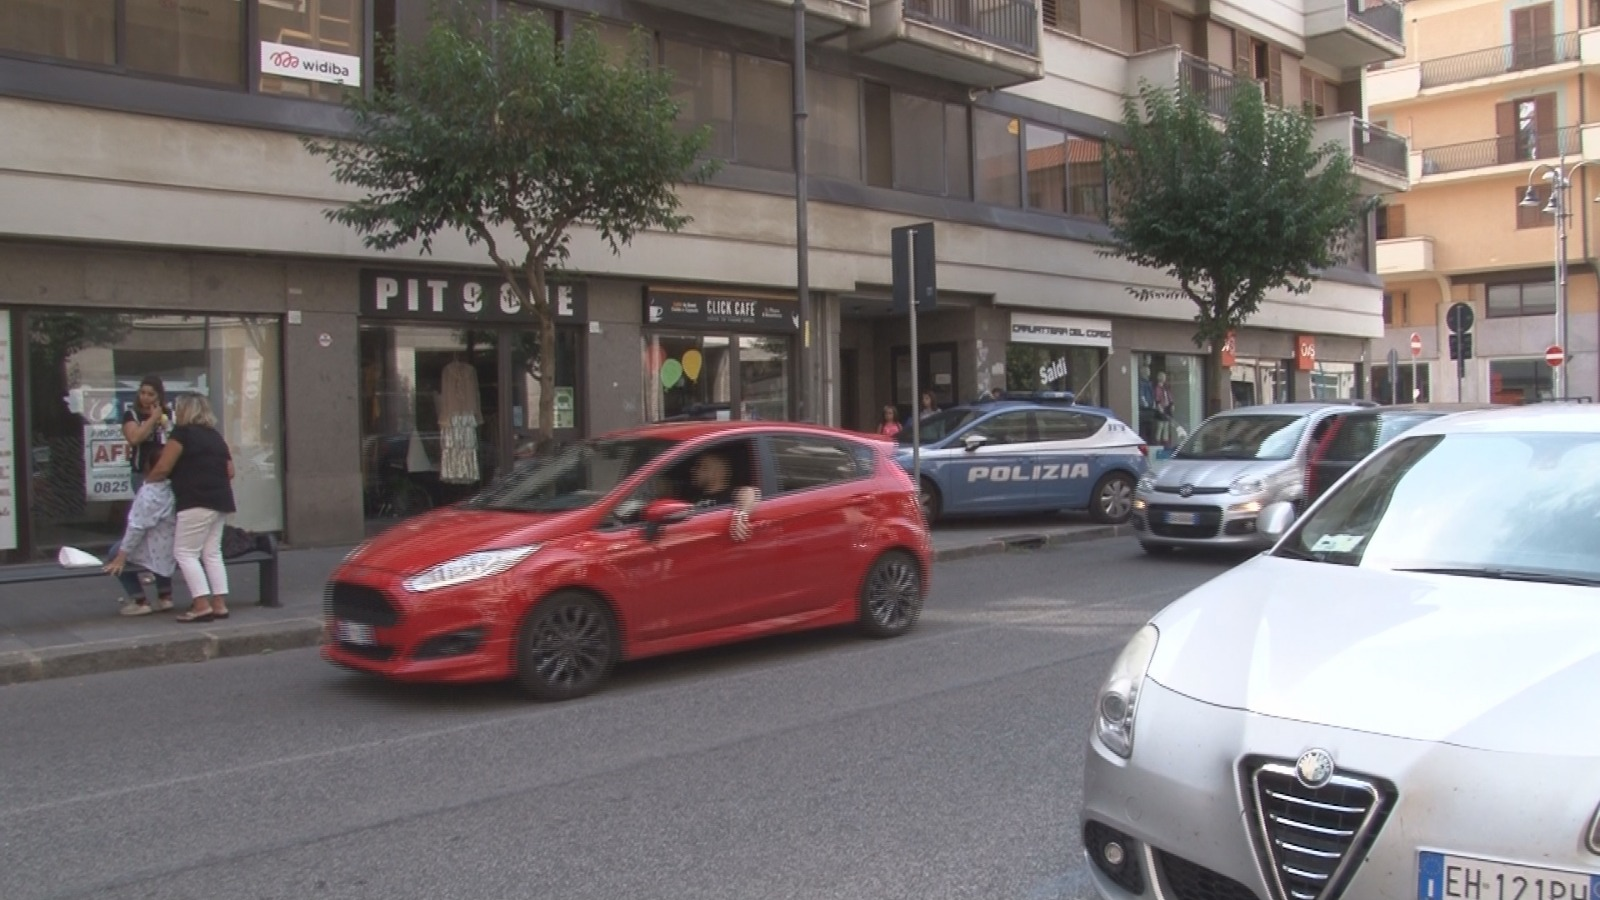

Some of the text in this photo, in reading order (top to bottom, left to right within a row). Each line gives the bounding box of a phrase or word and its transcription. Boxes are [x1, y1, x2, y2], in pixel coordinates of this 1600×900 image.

[302, 60, 349, 76] widiba
[376, 276, 448, 312] PIT
[706, 300, 732, 315] CLICK
[1039, 356, 1068, 385] Saldi
[967, 463, 1089, 483] POLIZIA
[93, 481, 129, 493] 0825
